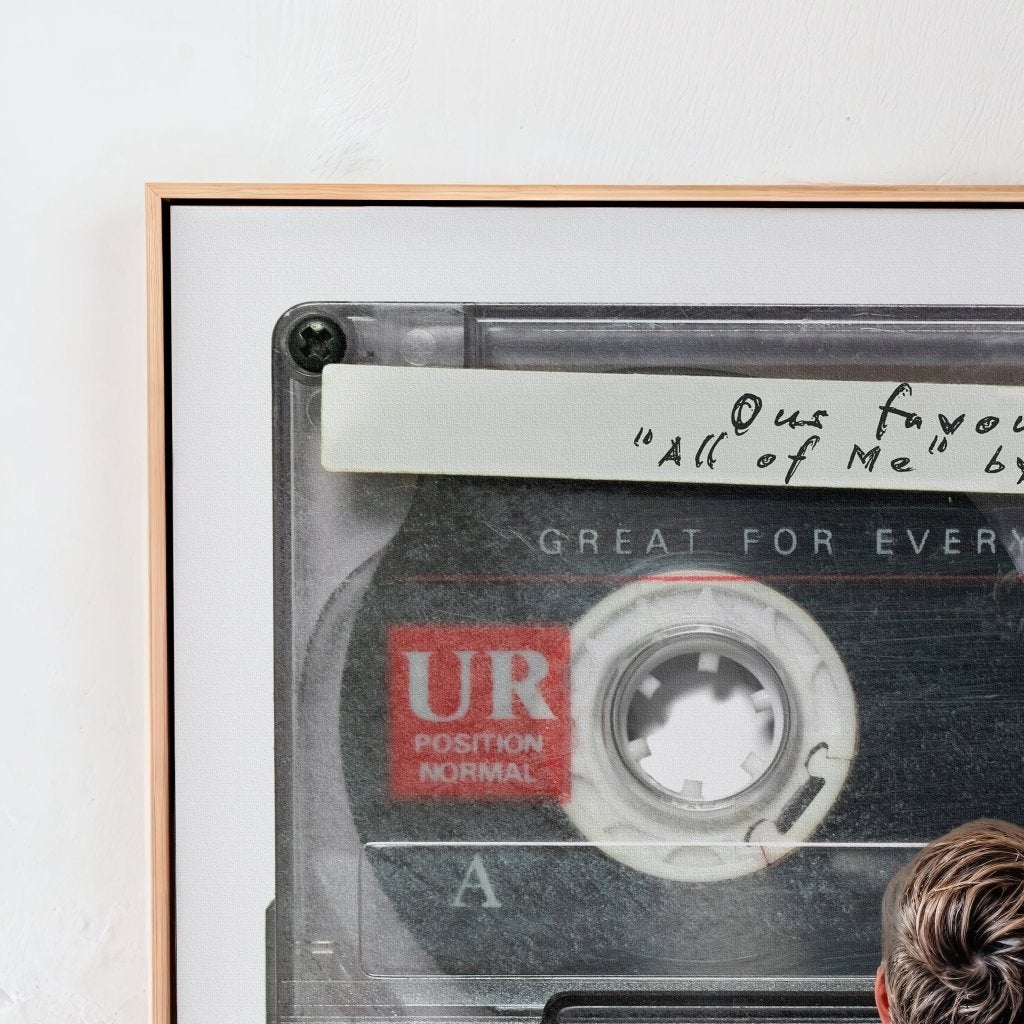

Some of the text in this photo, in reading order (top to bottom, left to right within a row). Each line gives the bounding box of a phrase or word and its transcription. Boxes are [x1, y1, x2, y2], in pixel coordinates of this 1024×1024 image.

[757, 435, 821, 484] of
[538, 528, 702, 555] GREAT
[743, 528, 834, 555] FOR
[402, 650, 558, 722] UR
[413, 732, 544, 755] POSITION
[418, 761, 538, 785] NORMAL
[452, 852, 502, 908] A
